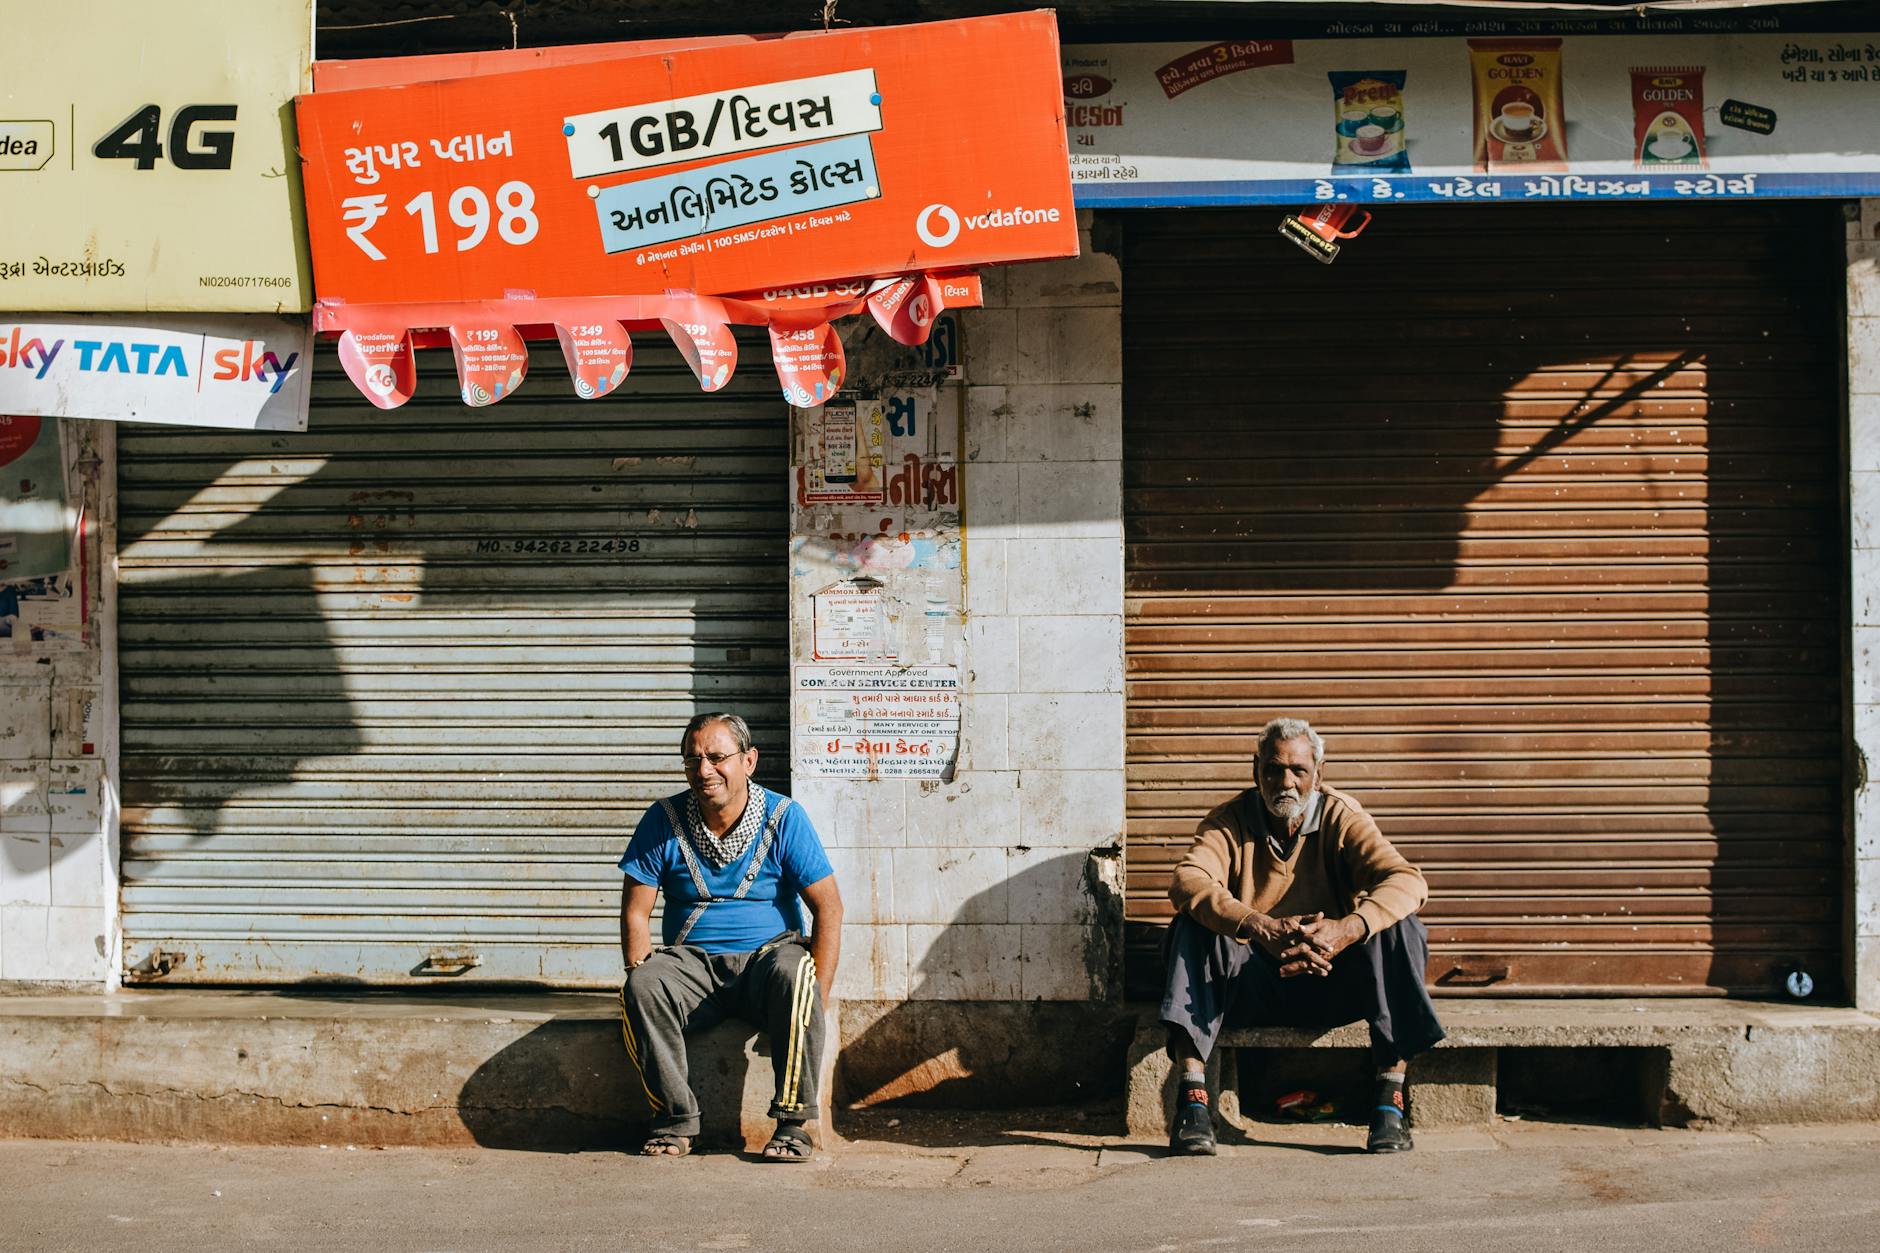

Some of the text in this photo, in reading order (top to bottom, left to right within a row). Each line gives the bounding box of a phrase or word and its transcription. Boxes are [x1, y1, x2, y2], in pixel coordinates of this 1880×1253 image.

[1213, 47, 1228, 62] 3
[1828, 44, 1861, 62] સોના
[1503, 55, 1529, 65] RAVI
[1487, 67, 1545, 80] GOLDEN
[1811, 70, 1825, 82] ચા
[1828, 70, 1838, 82] જ
[1072, 77, 1094, 94] રવિ
[1643, 88, 1694, 101] GOLDEN
[92, 104, 238, 170] 4G
[1077, 134, 1095, 146] ચા
[344, 130, 513, 185] સુપર પ્લાન
[1428, 176, 1501, 198] પટેલ
[1524, 175, 1651, 198] પ્રોવિઝન
[1673, 173, 1758, 196] સ્ટોર્સ
[610, 158, 865, 233] અનલિમિટેડ કોલ્સ
[964, 205, 1060, 231] vodafone
[713, 235, 733, 249] 100
[810, 216, 833, 229] દિવસ
[835, 211, 852, 223] માટે
[199, 277, 292, 288] NI020407176406
[944, 284, 969, 297] દિવસ
[363, 333, 396, 342] vodafone
[356, 342, 405, 354] SuperNet
[73, 339, 189, 377] TATA
[213, 339, 300, 394] sky
[577, 540, 640, 554] 22498
[829, 668, 882, 677] Government
[858, 679, 907, 688] SERVICE
[910, 679, 957, 688] CENTER
[861, 693, 883, 703] તમારી
[885, 693, 899, 703] પાસે
[903, 695, 926, 703] આધાર
[928, 693, 941, 703] કાર્ડ
